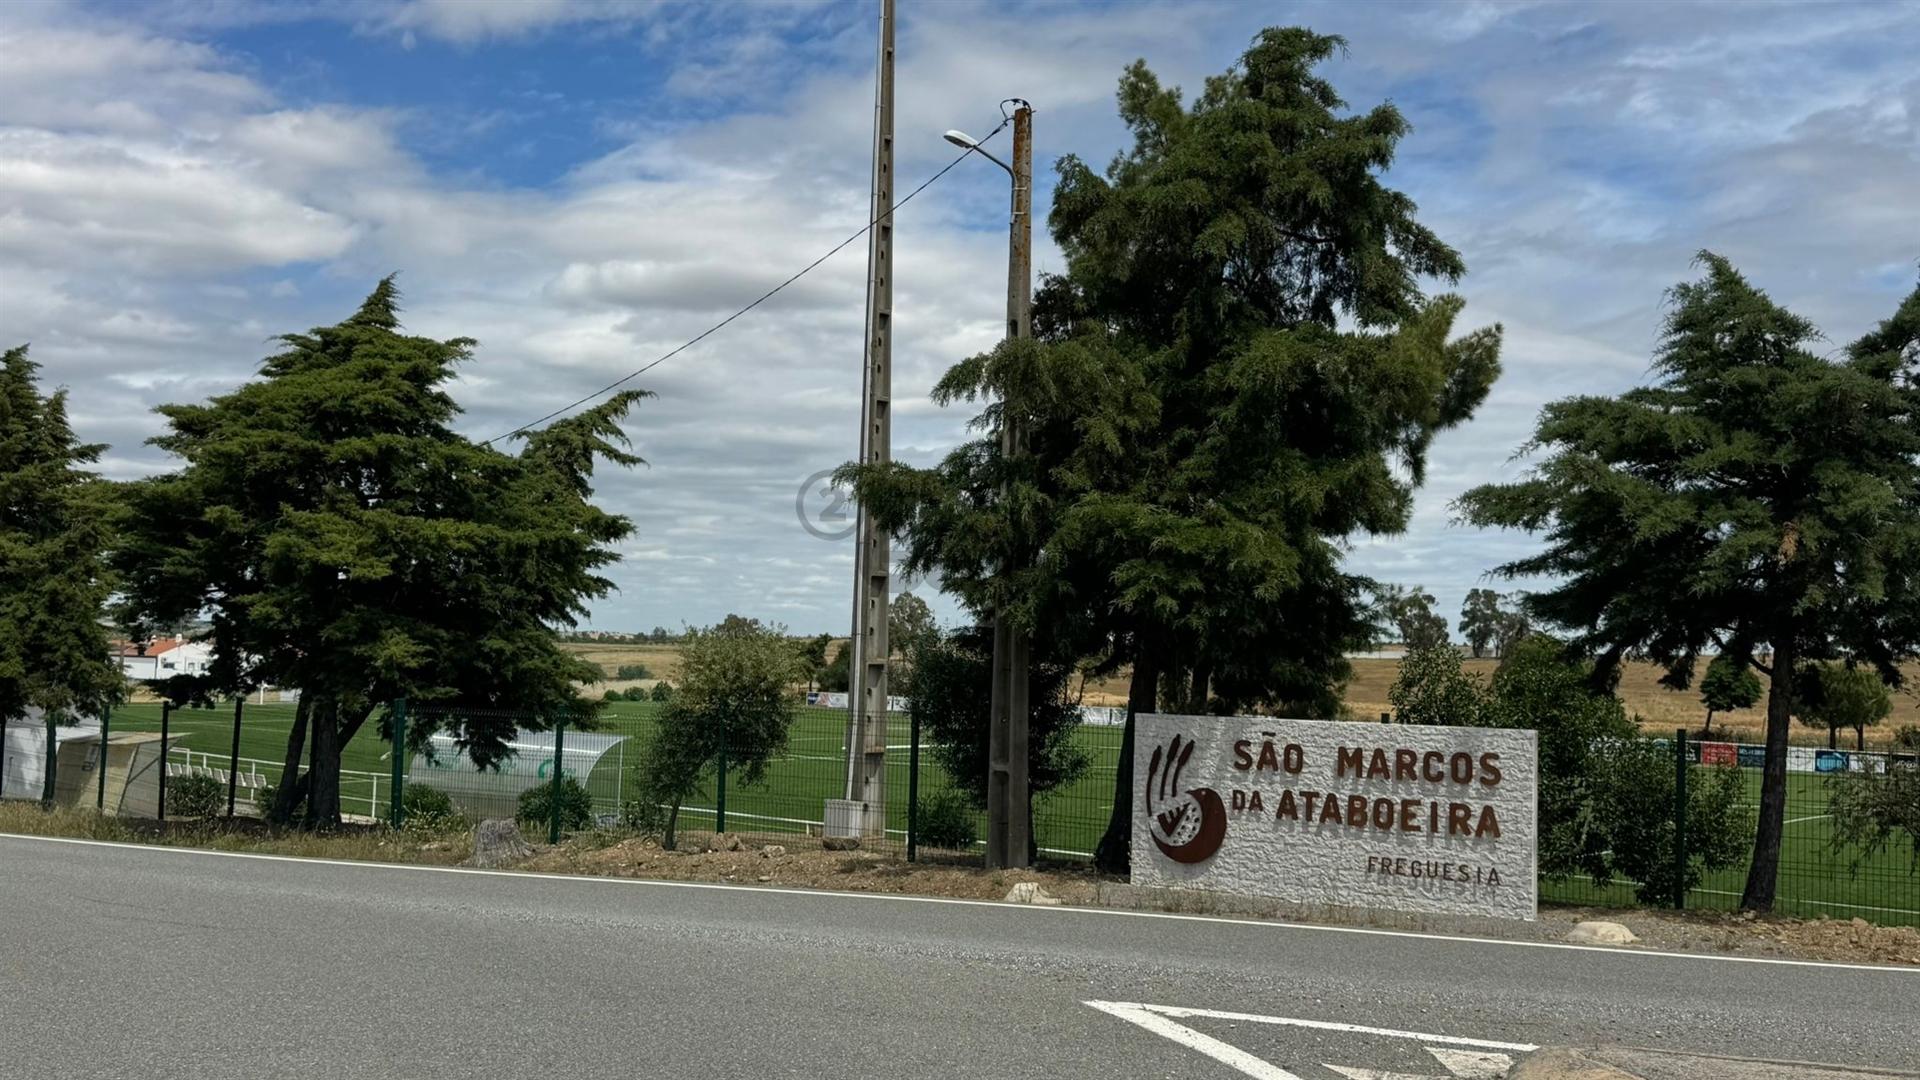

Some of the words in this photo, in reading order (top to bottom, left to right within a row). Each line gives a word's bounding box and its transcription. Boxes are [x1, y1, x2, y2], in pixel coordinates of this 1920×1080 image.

[1233, 732, 1304, 775] SÃO
[1337, 746, 1502, 787] MARCOS
[1232, 790, 1264, 812] DA
[1276, 790, 1501, 838] ATABOEIRA
[1367, 856, 1501, 886] FREGUESIA
